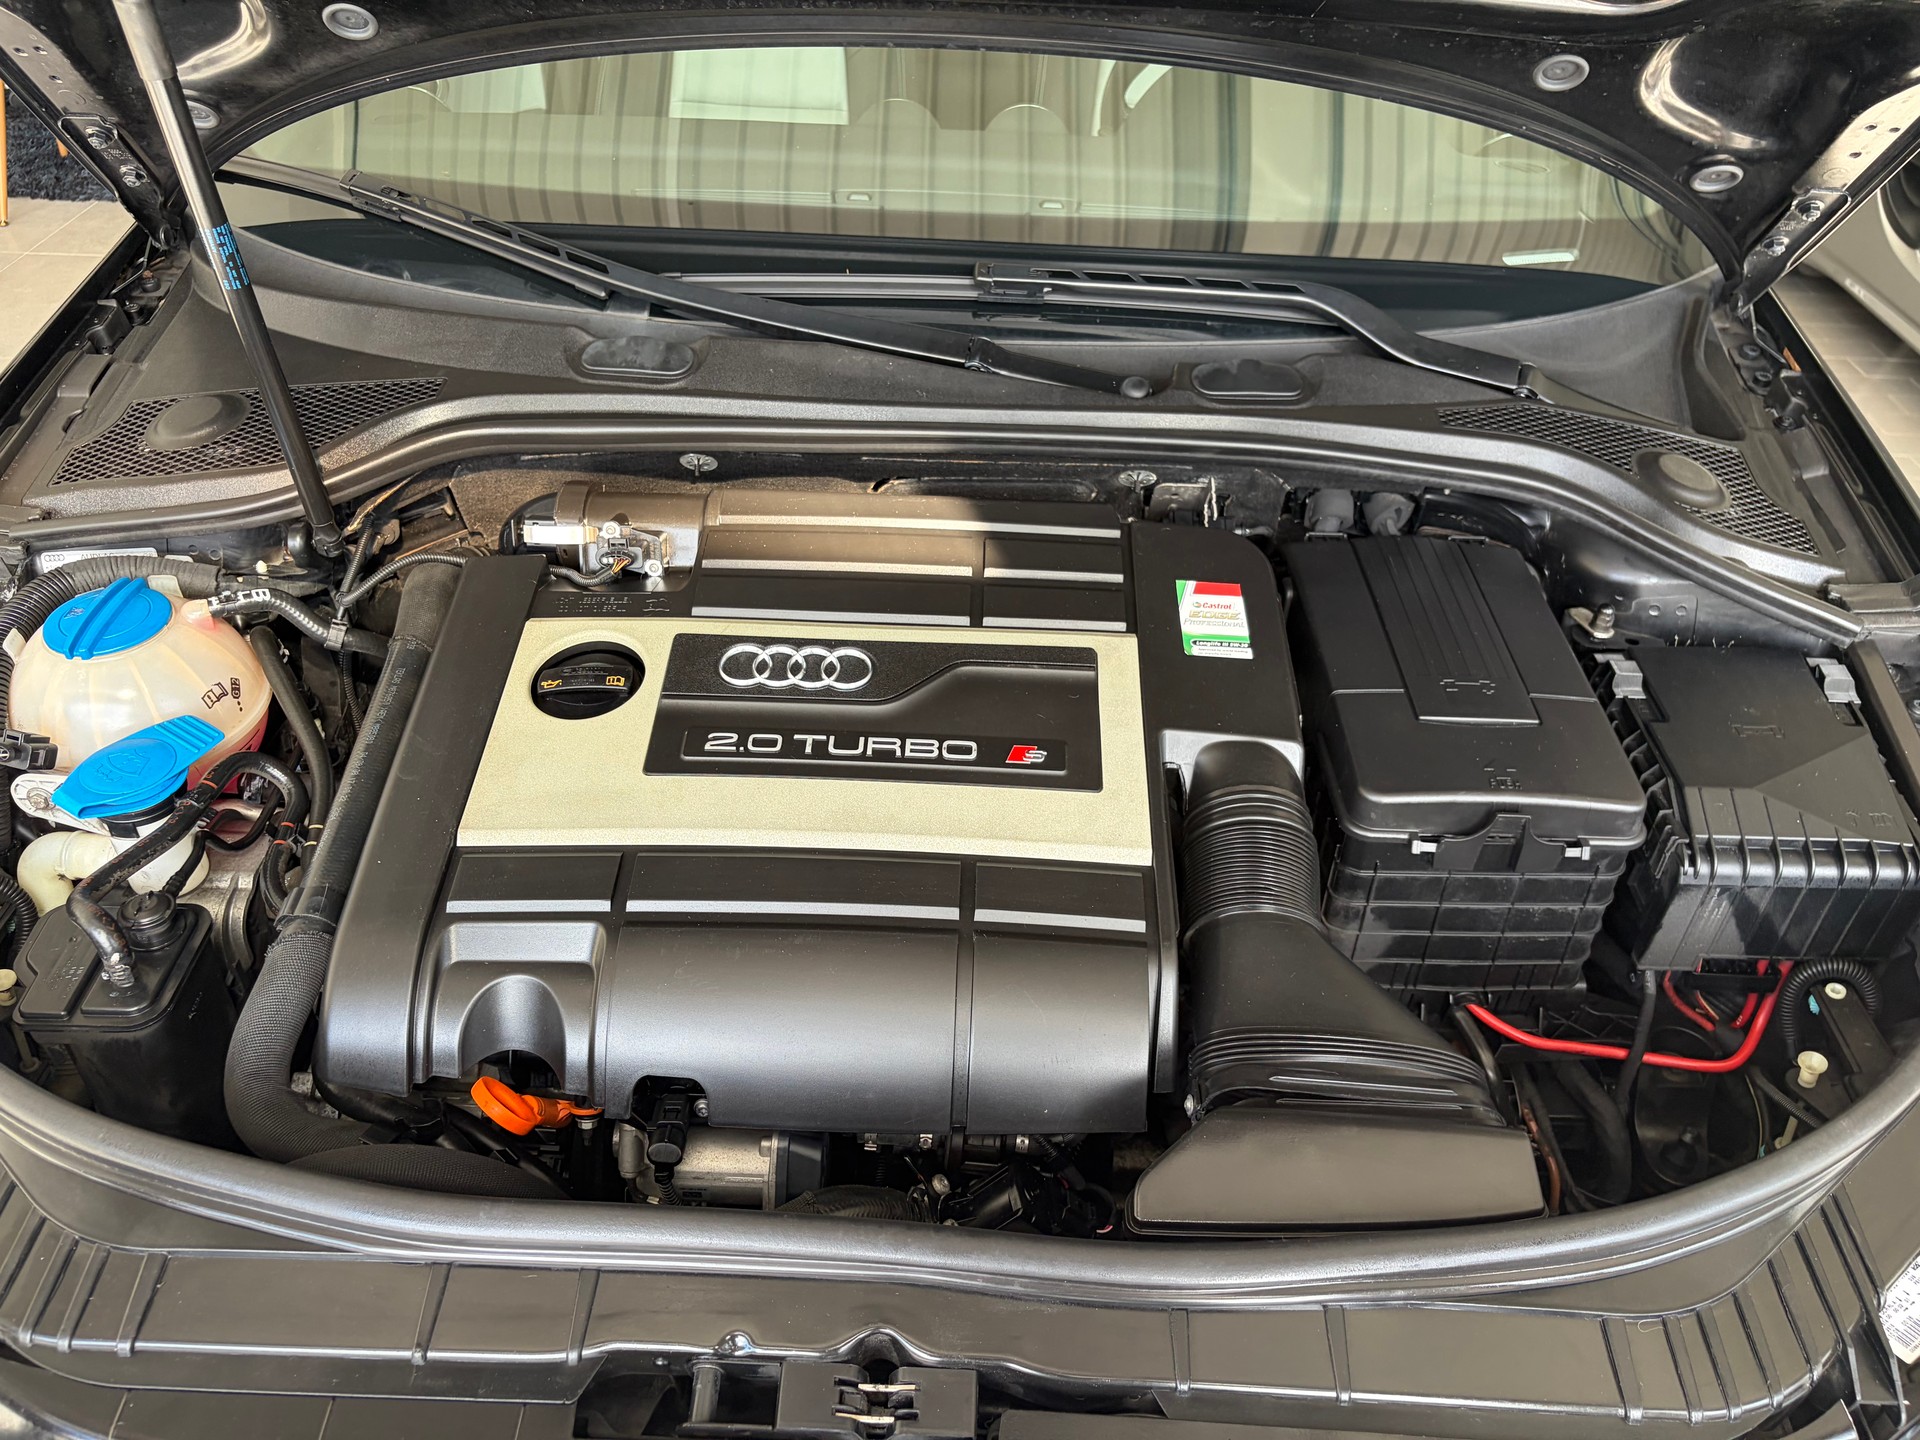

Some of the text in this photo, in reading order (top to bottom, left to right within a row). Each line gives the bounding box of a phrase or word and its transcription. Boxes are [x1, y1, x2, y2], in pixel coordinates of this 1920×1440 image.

[1202, 602, 1232, 610] Castrol
[703, 731, 783, 753] 2.0
[793, 733, 978, 761] TURBO
